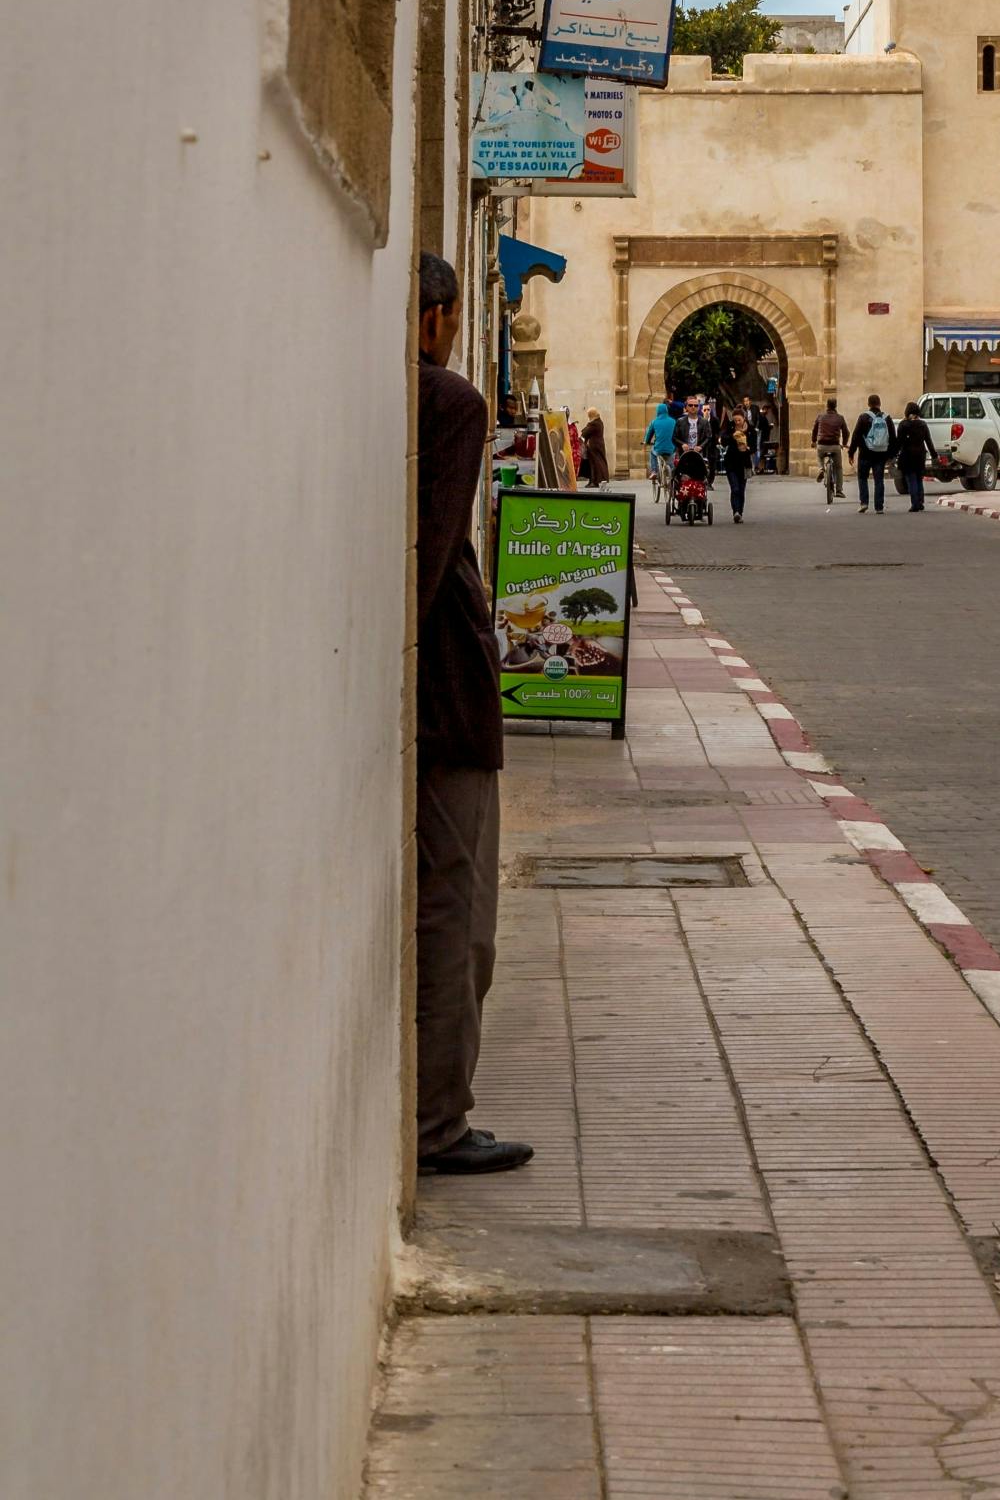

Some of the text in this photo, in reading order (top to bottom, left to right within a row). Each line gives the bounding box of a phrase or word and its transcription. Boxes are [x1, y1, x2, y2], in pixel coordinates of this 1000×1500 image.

[590, 91, 624, 100] MATERIELS
[587, 110, 613, 119] PHOTOS
[614, 110, 623, 119] CD
[512, 141, 576, 149] TOURISTIQUE
[487, 161, 568, 171] D'ESSAOUIRA
[581, 512, 621, 536] زيت
[508, 541, 551, 555] Huile
[506, 561, 616, 594] Organic Argan oil
[563, 689, 592, 699] 100%
